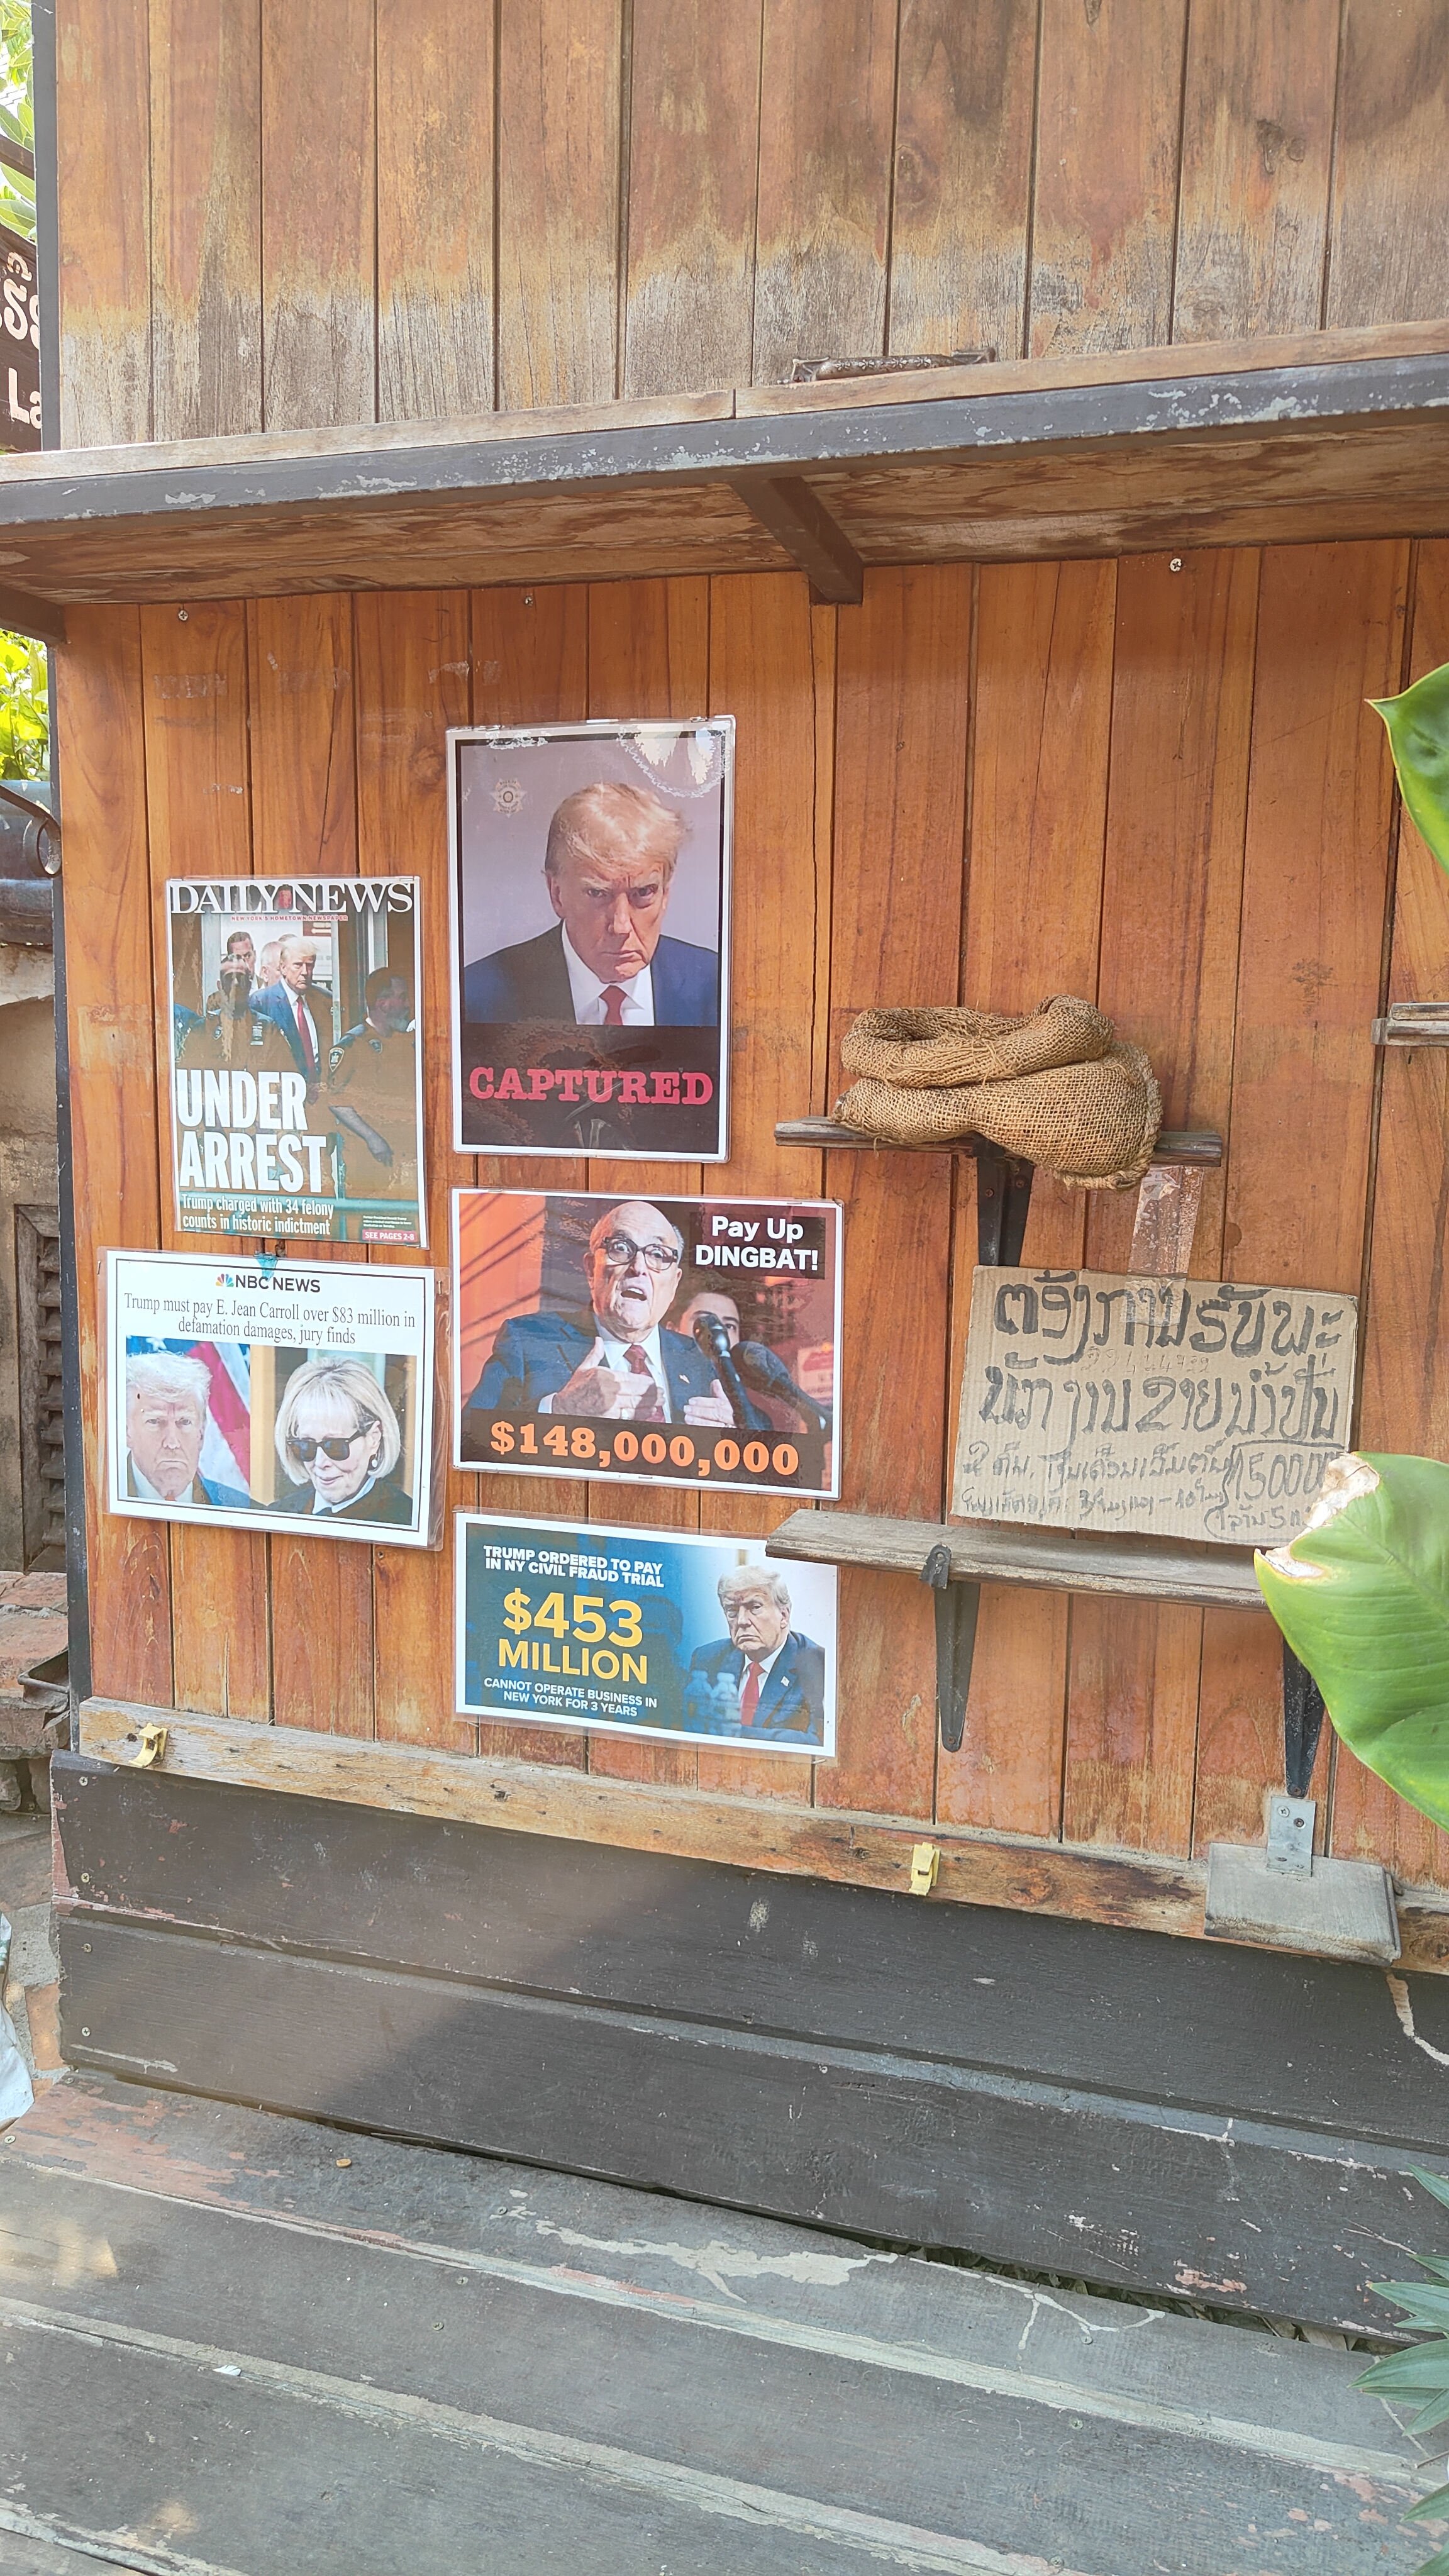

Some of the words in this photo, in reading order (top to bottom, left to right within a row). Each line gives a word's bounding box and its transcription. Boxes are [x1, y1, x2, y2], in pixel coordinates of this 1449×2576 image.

[170, 884, 280, 914] DAILY
[287, 882, 413, 913] NEWS
[177, 1069, 308, 1130] UNDER
[469, 1067, 713, 1105] CAPTURED
[179, 1131, 327, 1193] ARREST
[181, 1194, 213, 1213] Trump
[216, 1196, 257, 1214] charged
[260, 1197, 283, 1214] with
[285, 1198, 299, 1214] 34
[301, 1199, 334, 1220] felony
[182, 1213, 217, 1230] counts
[219, 1214, 230, 1230] in
[232, 1214, 272, 1232] historic
[274, 1216, 331, 1235] indictment
[379, 1232, 402, 1240] PAGES
[711, 1215, 761, 1242] Pay
[767, 1218, 804, 1244] Up
[696, 1245, 818, 1271] DINGBAT!
[235, 1274, 270, 1290] NBC
[273, 1277, 321, 1293] NEWS
[125, 1292, 160, 1314] Trump
[164, 1299, 191, 1313] must
[193, 1301, 213, 1318] pay
[216, 1299, 228, 1316] E.
[231, 1300, 256, 1317] Jean
[260, 1302, 299, 1320] Carroll
[303, 1309, 329, 1322] over
[332, 1306, 353, 1324] $83
[357, 1308, 400, 1327] million
[404, 1311, 416, 1328] in
[179, 1316, 240, 1336] defamation
[243, 1321, 296, 1343] damages,
[298, 1324, 323, 1346] jury
[327, 1326, 355, 1345] finds
[491, 1421, 799, 1477] $148,000,000
[483, 1545, 535, 1561] TRUMP
[538, 1550, 608, 1569] ORDERED
[611, 1558, 631, 1571] TO
[634, 1560, 663, 1575] PAY
[486, 1557, 501, 1570] IN
[504, 1560, 526, 1572] NY
[528, 1562, 566, 1577] CIVIL
[569, 1566, 619, 1582] FRAUD
[622, 1572, 665, 1588] TRIAL
[503, 1587, 643, 1648] $453
[499, 1638, 647, 1685] MILLION
[484, 1677, 532, 1692] CANNOT
[535, 1683, 585, 1698] OPERATE
[587, 1689, 643, 1706] BUSINESS
[645, 1697, 658, 1708] IN
[504, 1690, 530, 1702] NEW
[533, 1694, 563, 1707] YORK
[565, 1697, 589, 1710] FOR
[591, 1701, 598, 1711] 3
[601, 1702, 638, 1717] YEARS
